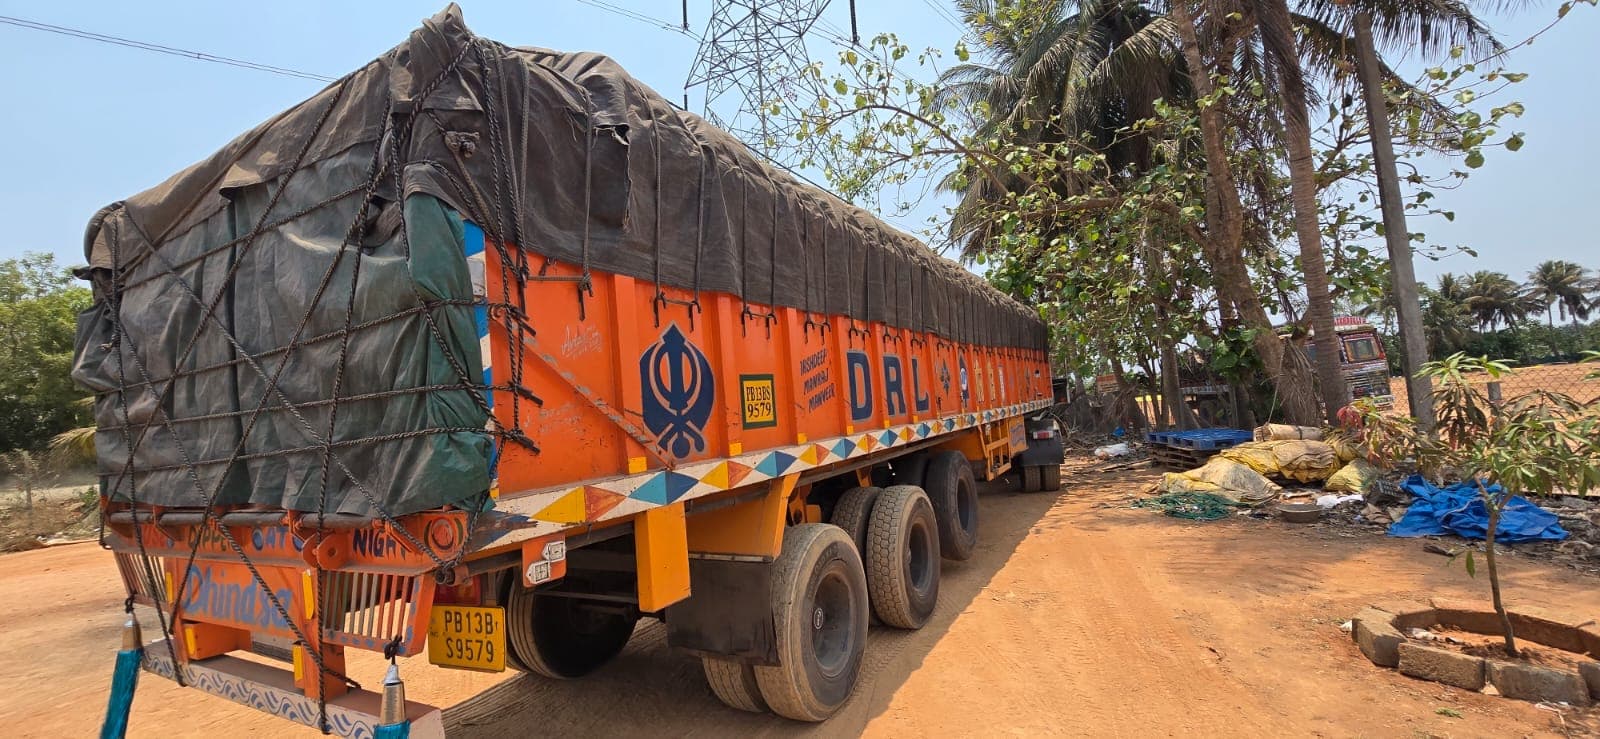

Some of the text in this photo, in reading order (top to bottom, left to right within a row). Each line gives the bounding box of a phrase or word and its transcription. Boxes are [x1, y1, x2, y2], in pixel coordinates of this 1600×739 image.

[746, 386, 771, 401] PB13BS
[846, 351, 931, 421] DRL
[747, 402, 771, 418] 9579
[182, 564, 293, 628] Dhindsa
[444, 610, 494, 635] PB13B
[446, 637, 494, 663] S9579
